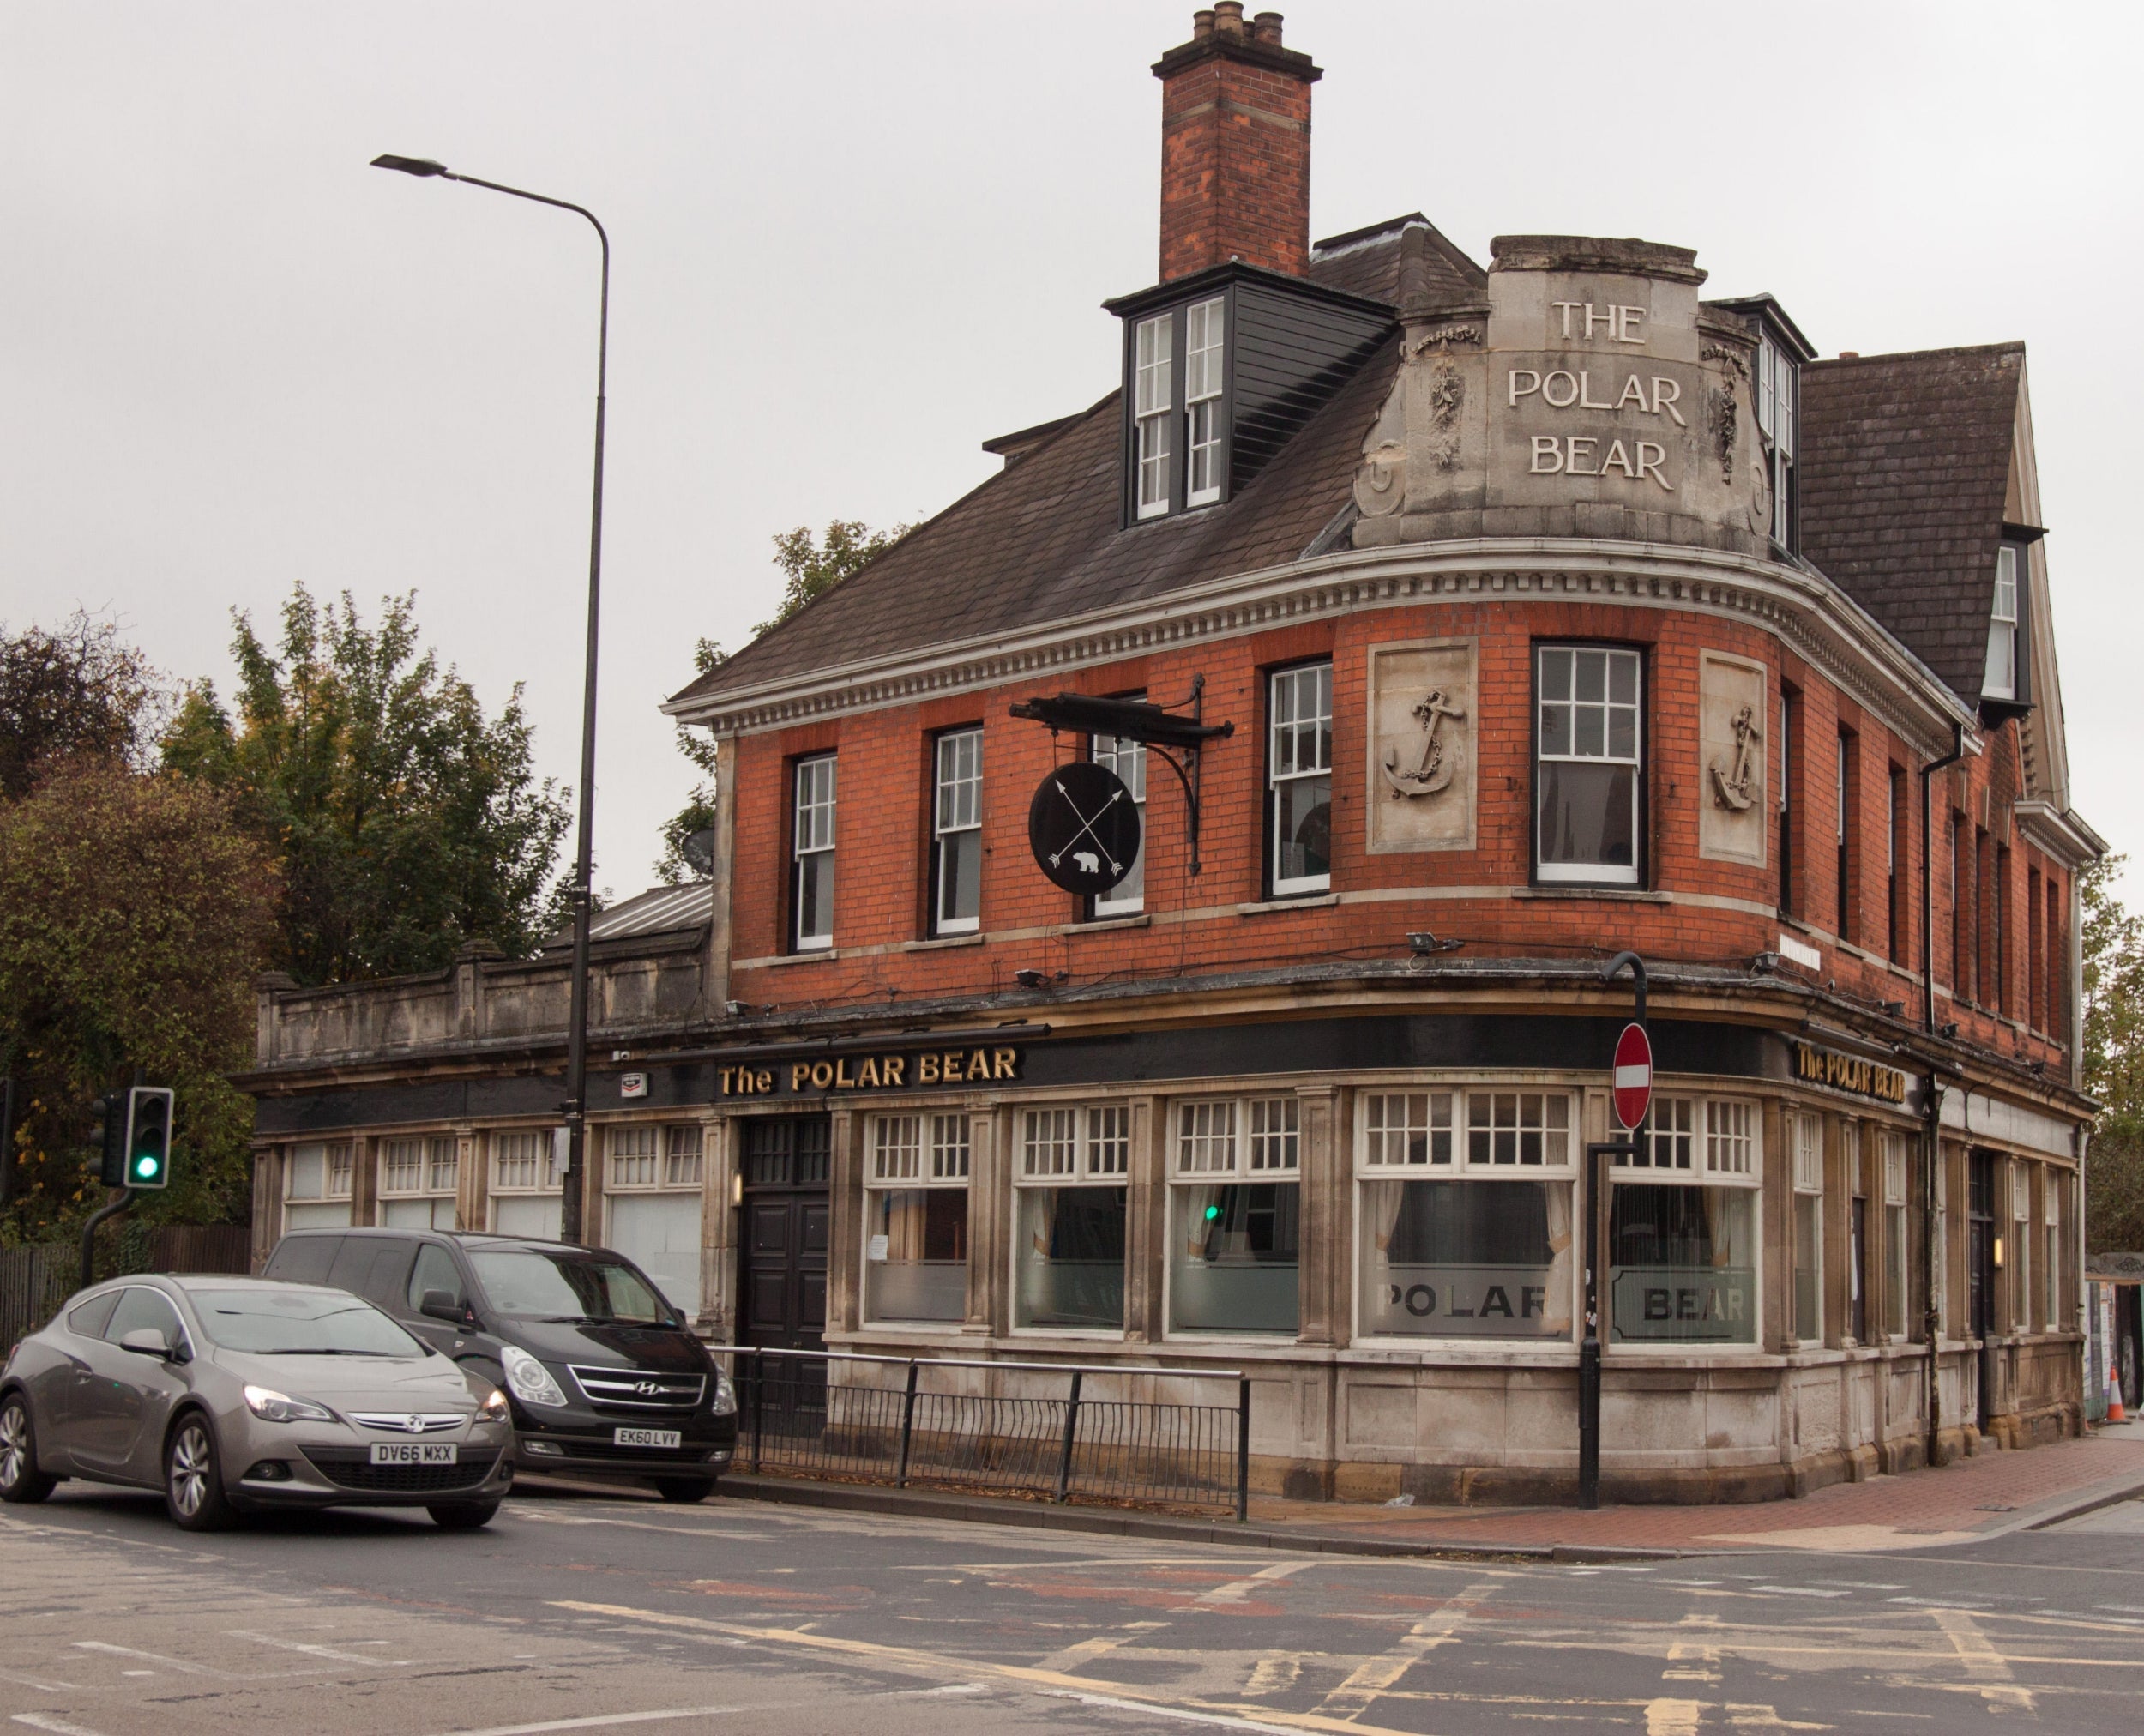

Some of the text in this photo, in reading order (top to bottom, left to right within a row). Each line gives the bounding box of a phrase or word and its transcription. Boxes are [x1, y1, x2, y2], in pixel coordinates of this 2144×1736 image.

[1551, 301, 1647, 344] THE
[1507, 369, 1688, 428] POLAR
[1528, 435, 1674, 491] BEAR
[718, 1046, 1017, 1095] The POLAR BEAR
[1797, 1041, 1906, 1104] The POLAR BEAR
[1644, 1288, 1744, 1321] BEAR
[378, 1445, 451, 1462] DV66 MXX
[620, 1430, 677, 1446] EK60 LVV
